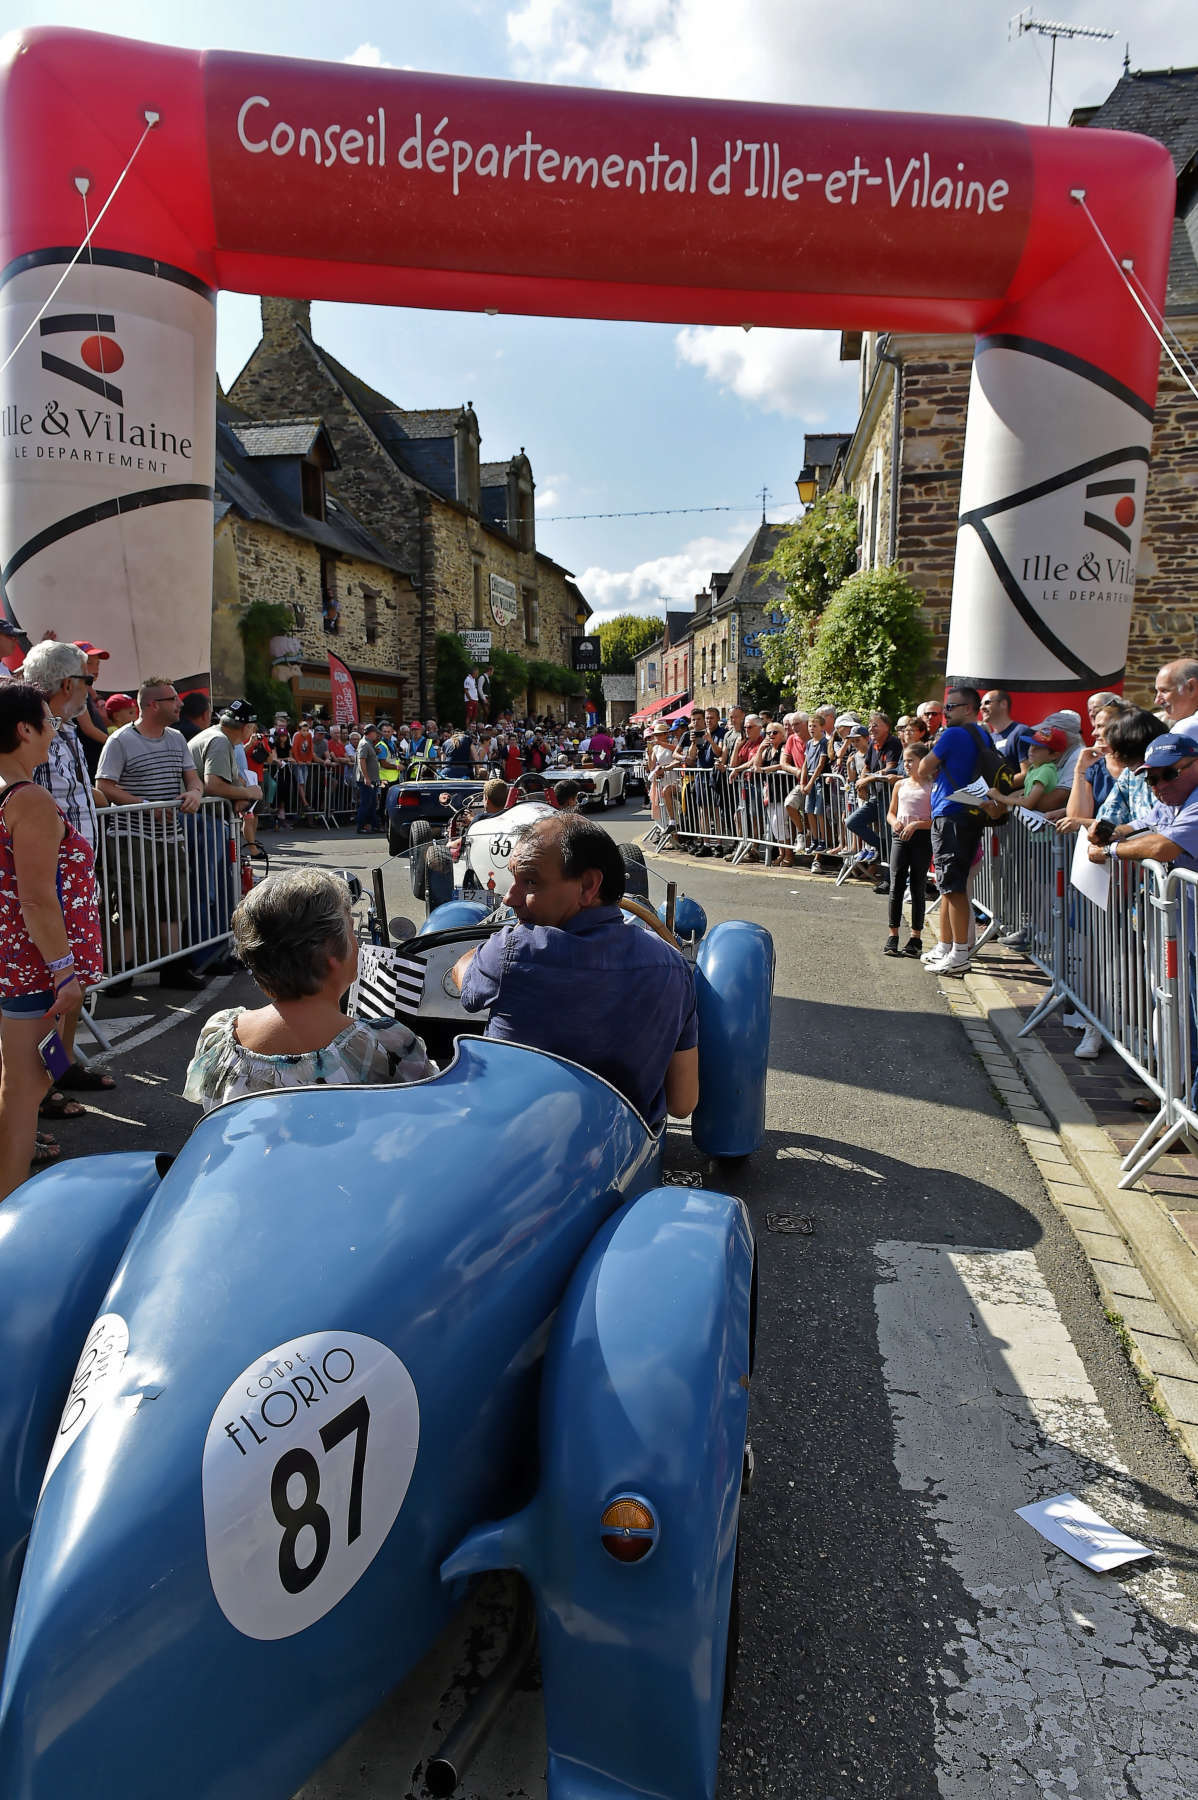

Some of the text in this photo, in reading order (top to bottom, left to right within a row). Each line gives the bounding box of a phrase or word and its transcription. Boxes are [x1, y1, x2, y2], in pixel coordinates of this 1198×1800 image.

[237, 96, 1009, 215] Conseil départemental d'Ille-et-Vilaine
[41, 400, 71, 438] &
[75, 408, 192, 459] Vilaine
[14, 446, 168, 474] LE DEPARTEMENT
[1022, 555, 1069, 581] Ille
[1077, 551, 1101, 582] &
[1043, 590, 1059, 601] LE
[490, 832, 512, 857] 35
[246, 1352, 306, 1398] COUPE
[224, 1348, 354, 1455] FLORIO
[270, 1395, 370, 1595] 87
